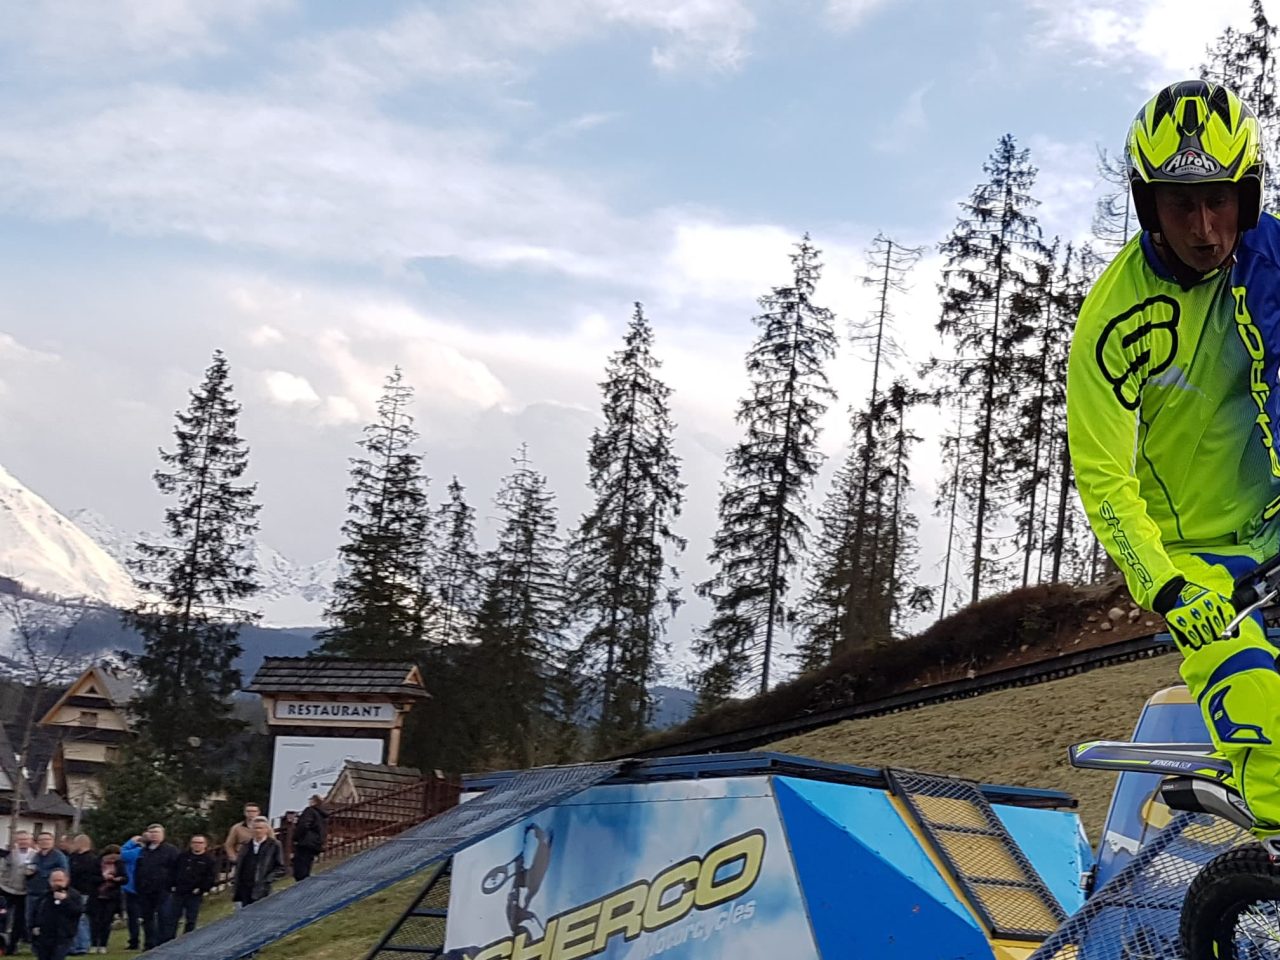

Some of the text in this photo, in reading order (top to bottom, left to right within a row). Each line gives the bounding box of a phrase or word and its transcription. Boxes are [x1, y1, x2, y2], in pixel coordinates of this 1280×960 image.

[1165, 151, 1215, 172] Airoh
[1099, 500, 1154, 591] SHERC
[287, 704, 382, 717] RESTAURANT
